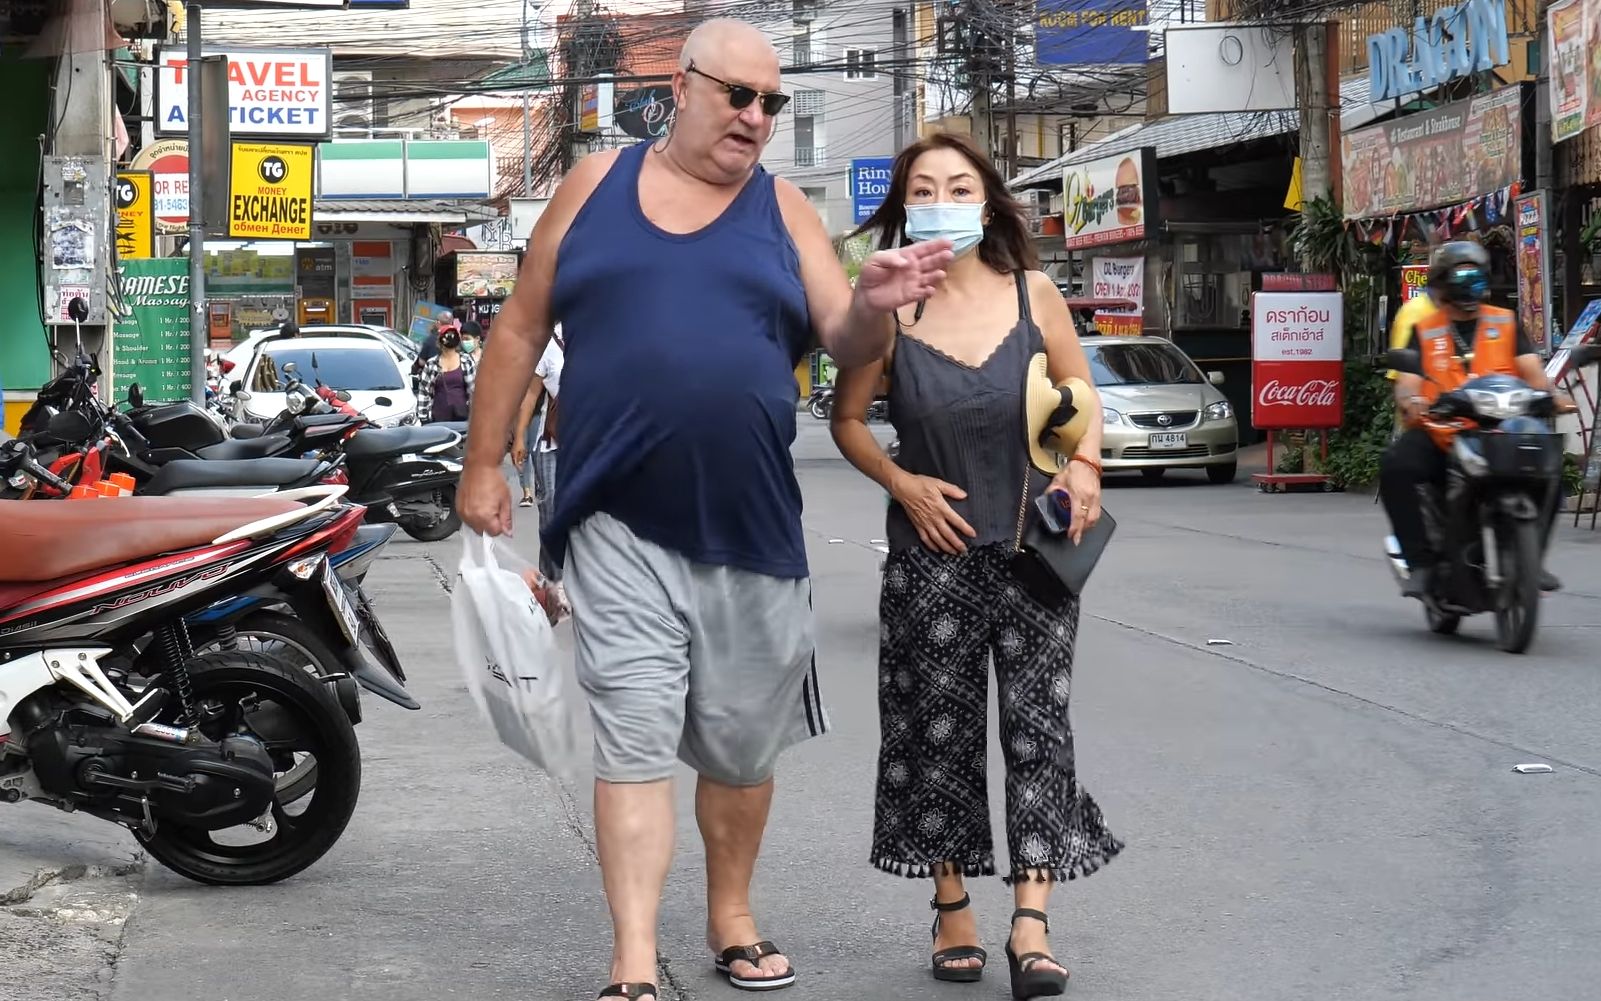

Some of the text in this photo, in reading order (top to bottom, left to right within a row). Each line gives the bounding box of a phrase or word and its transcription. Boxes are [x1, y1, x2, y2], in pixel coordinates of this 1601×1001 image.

[1039, 9, 1146, 27] ROOM FOR RENT
[1367, 0, 1509, 102] DRAGON
[167, 59, 320, 87] TAVEL
[242, 89, 319, 102] AGENCY
[263, 162, 283, 178] TG
[154, 181, 189, 195] OR RE
[257, 186, 287, 196] MONEY
[858, 182, 889, 195] Hou
[233, 195, 307, 224] EXCHANGE
[233, 222, 269, 232] обмен
[271, 224, 305, 235] Денег
[1405, 270, 1428, 287] Che
[1266, 306, 1329, 324] ดราก้อน
[1271, 328, 1324, 342] สเต็กเฮ้าส์
[1259, 379, 1340, 406] Coca-Cola
[1165, 434, 1185, 442] 4814
